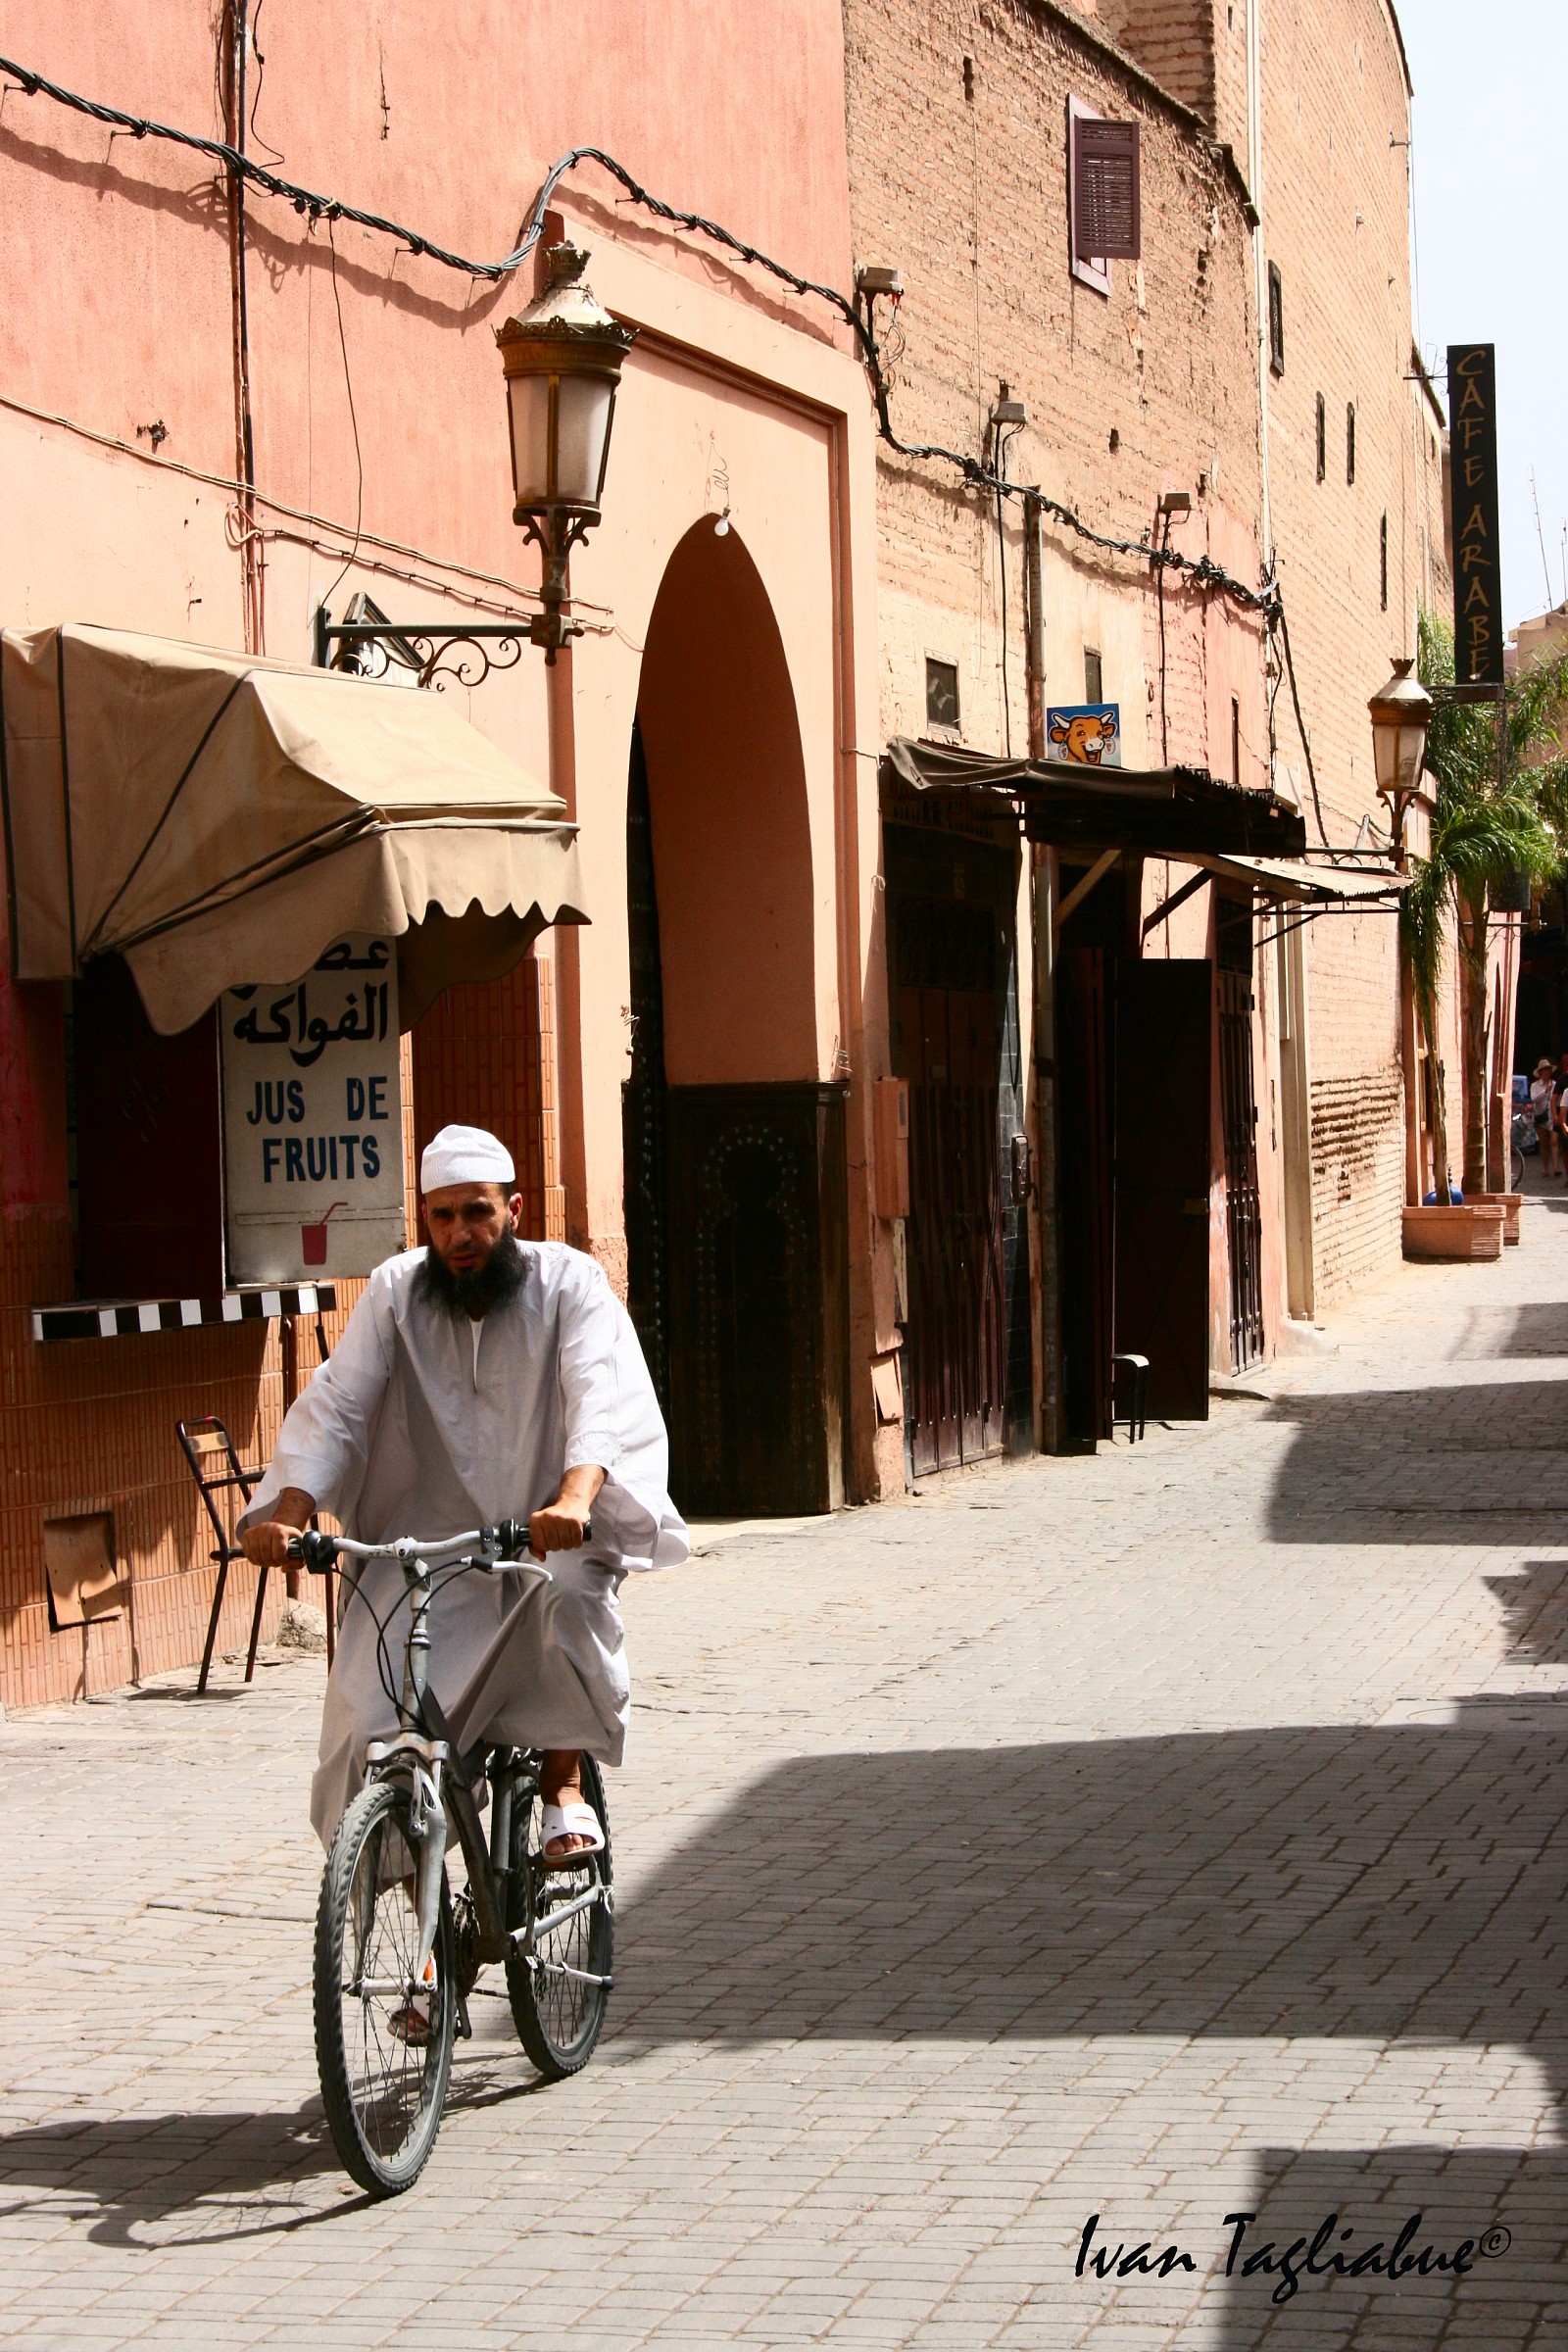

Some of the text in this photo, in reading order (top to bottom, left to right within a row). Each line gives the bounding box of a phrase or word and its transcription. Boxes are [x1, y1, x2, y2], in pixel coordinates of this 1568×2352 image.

[1456, 350, 1492, 676] CAFE ARABE
[247, 1076, 389, 1125] JUS DE
[262, 1135, 380, 1183] FRUITS
